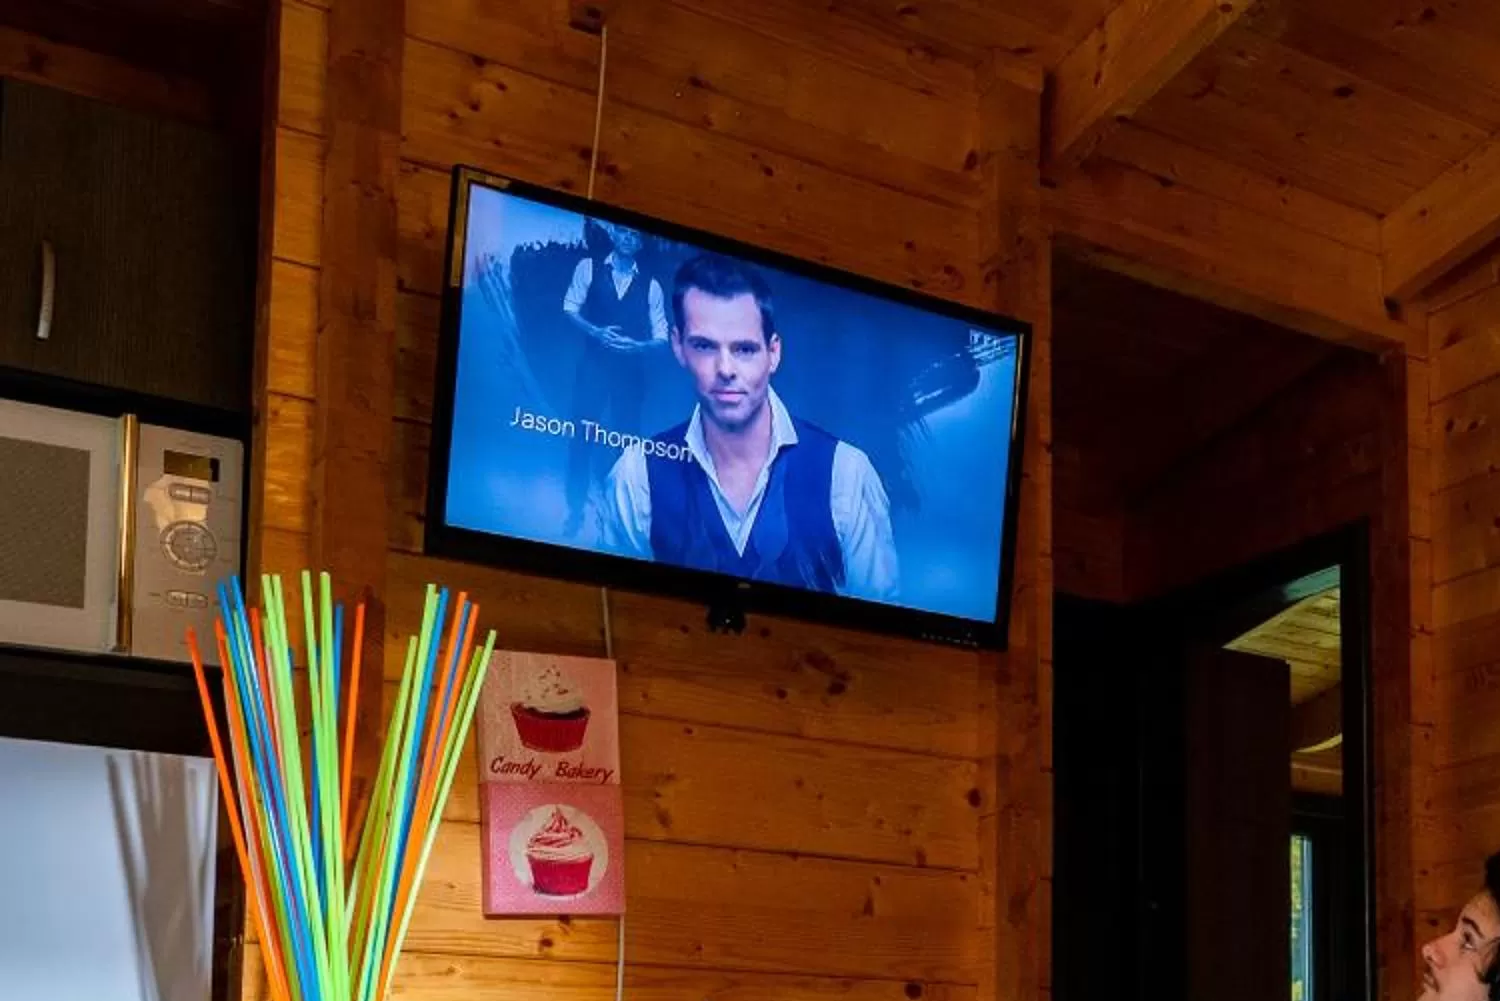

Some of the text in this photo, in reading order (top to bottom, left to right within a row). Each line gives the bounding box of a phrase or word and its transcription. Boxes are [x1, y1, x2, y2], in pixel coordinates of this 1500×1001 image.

[510, 406, 694, 462] Jason Thompson
[490, 755, 614, 784] Candy Bakery
